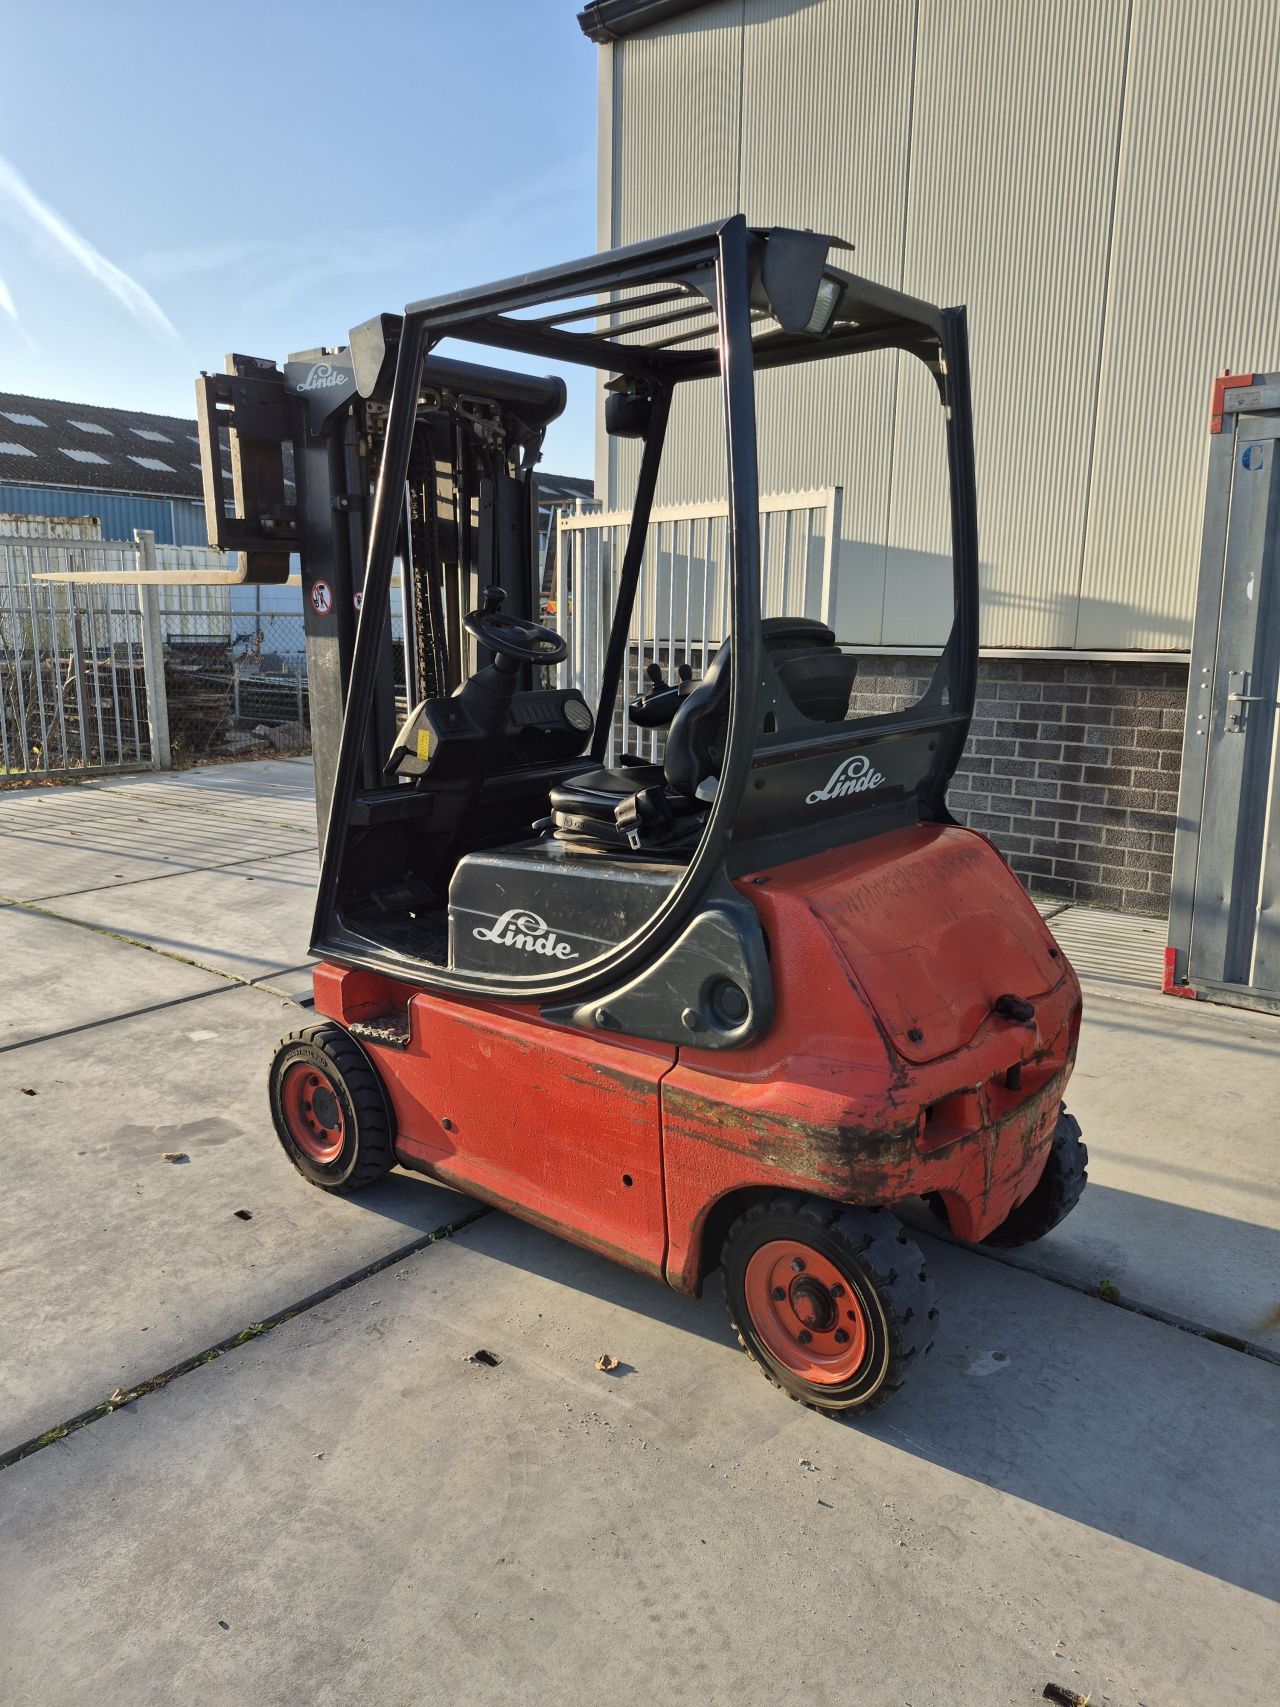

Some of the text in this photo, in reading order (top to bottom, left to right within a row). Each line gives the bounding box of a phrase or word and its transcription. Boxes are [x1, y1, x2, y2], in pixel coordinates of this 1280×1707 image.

[296, 363, 348, 392] Linde
[1242, 444, 1264, 471] C
[805, 755, 886, 805] Linde
[472, 908, 580, 960] Linde
